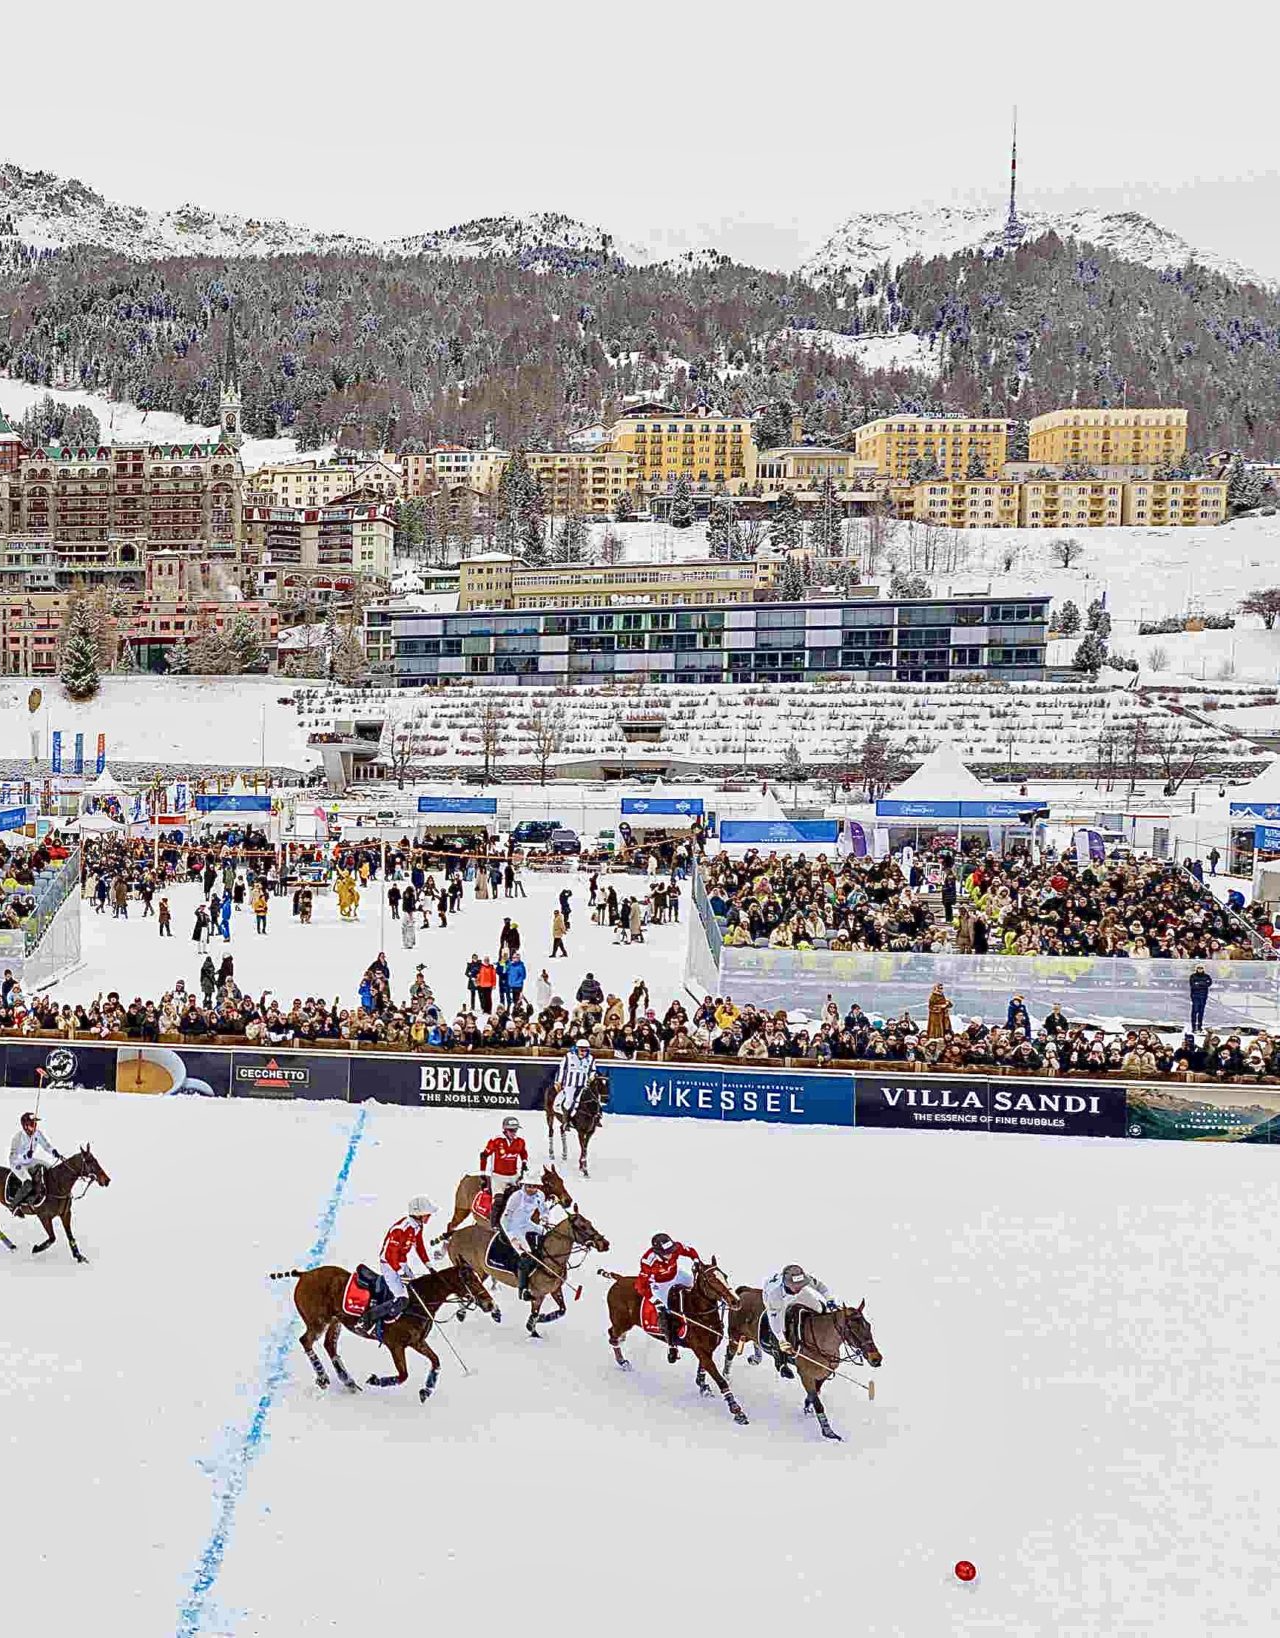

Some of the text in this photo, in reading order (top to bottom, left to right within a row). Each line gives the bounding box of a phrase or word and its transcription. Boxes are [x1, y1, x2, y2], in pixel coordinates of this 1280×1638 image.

[239, 1068, 305, 1080] CECCHETTO
[420, 1066, 520, 1094] BELUGA
[420, 1093, 520, 1105] THE NOBLE VODKA
[675, 1087, 805, 1113] KESSEL
[880, 1087, 1101, 1114] VILLA SANDI
[913, 1112, 1066, 1127] THE ESSENCE OF FINE BUBBLES
